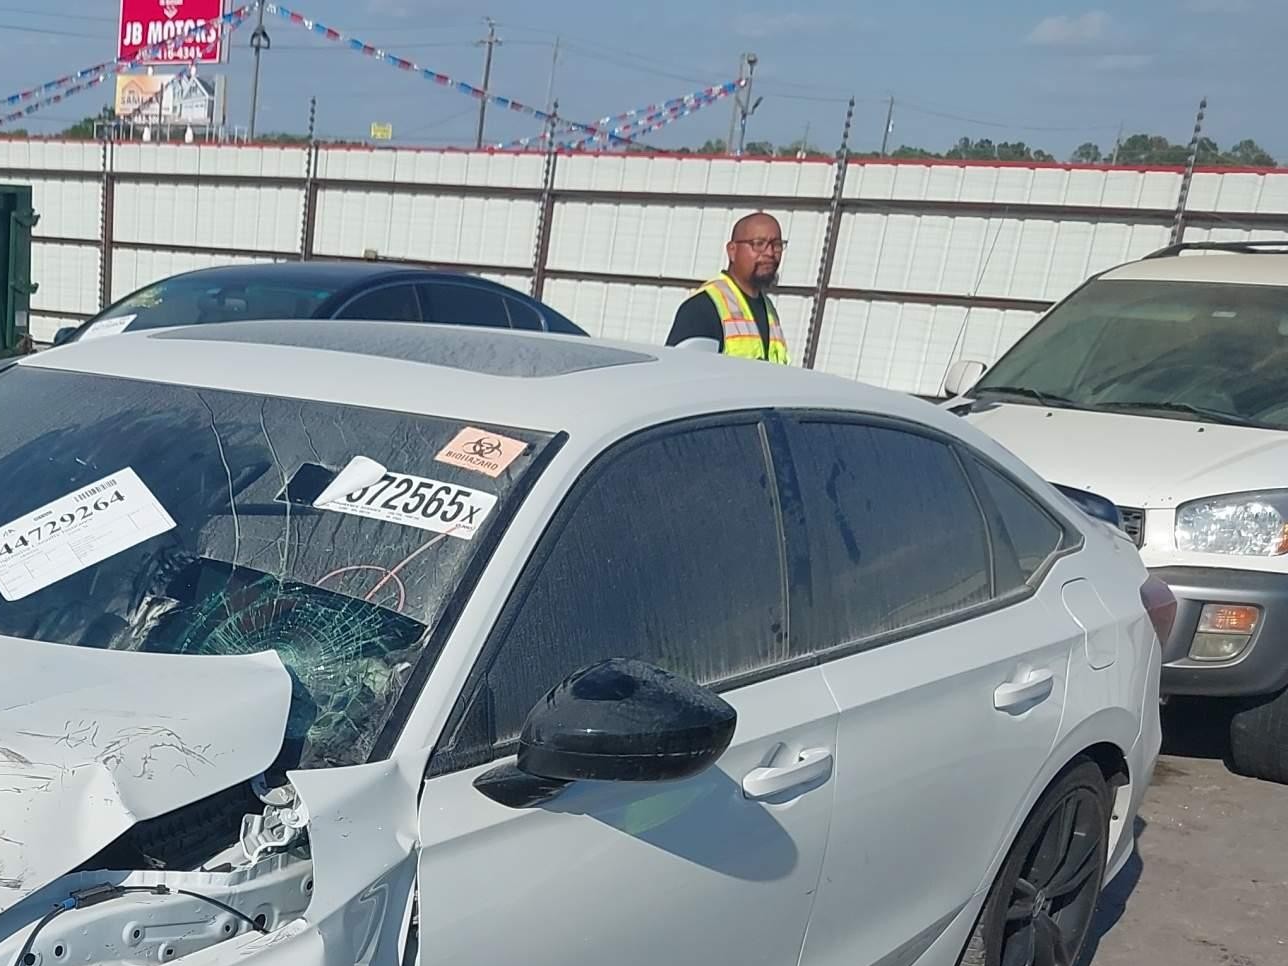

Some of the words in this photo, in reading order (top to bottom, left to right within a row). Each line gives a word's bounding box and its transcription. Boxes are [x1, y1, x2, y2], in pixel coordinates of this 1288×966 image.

[123, 21, 143, 46] JB
[147, 19, 217, 45] MOTORS
[445, 450, 499, 471] BIOHAZARD
[0, 489, 126, 557] 44729264
